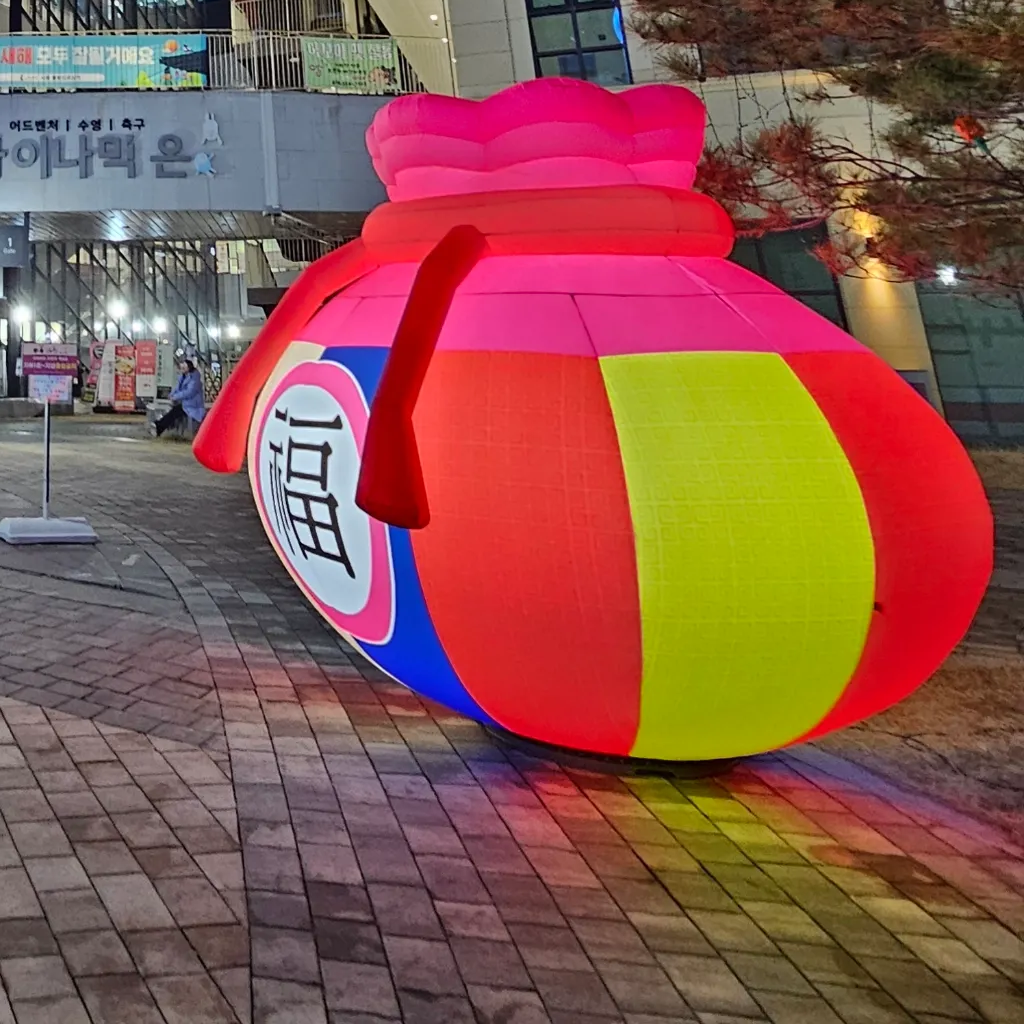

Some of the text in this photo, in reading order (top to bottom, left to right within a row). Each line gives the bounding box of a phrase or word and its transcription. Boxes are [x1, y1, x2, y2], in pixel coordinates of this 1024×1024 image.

[0, 45, 35, 67] 새해
[36, 45, 70, 67] 모두
[9, 118, 146, 131] 어드벤처 수영 축구
[150, 133, 193, 179] 온
[7, 237, 13, 248] 1
[268, 408, 356, 580] 福
